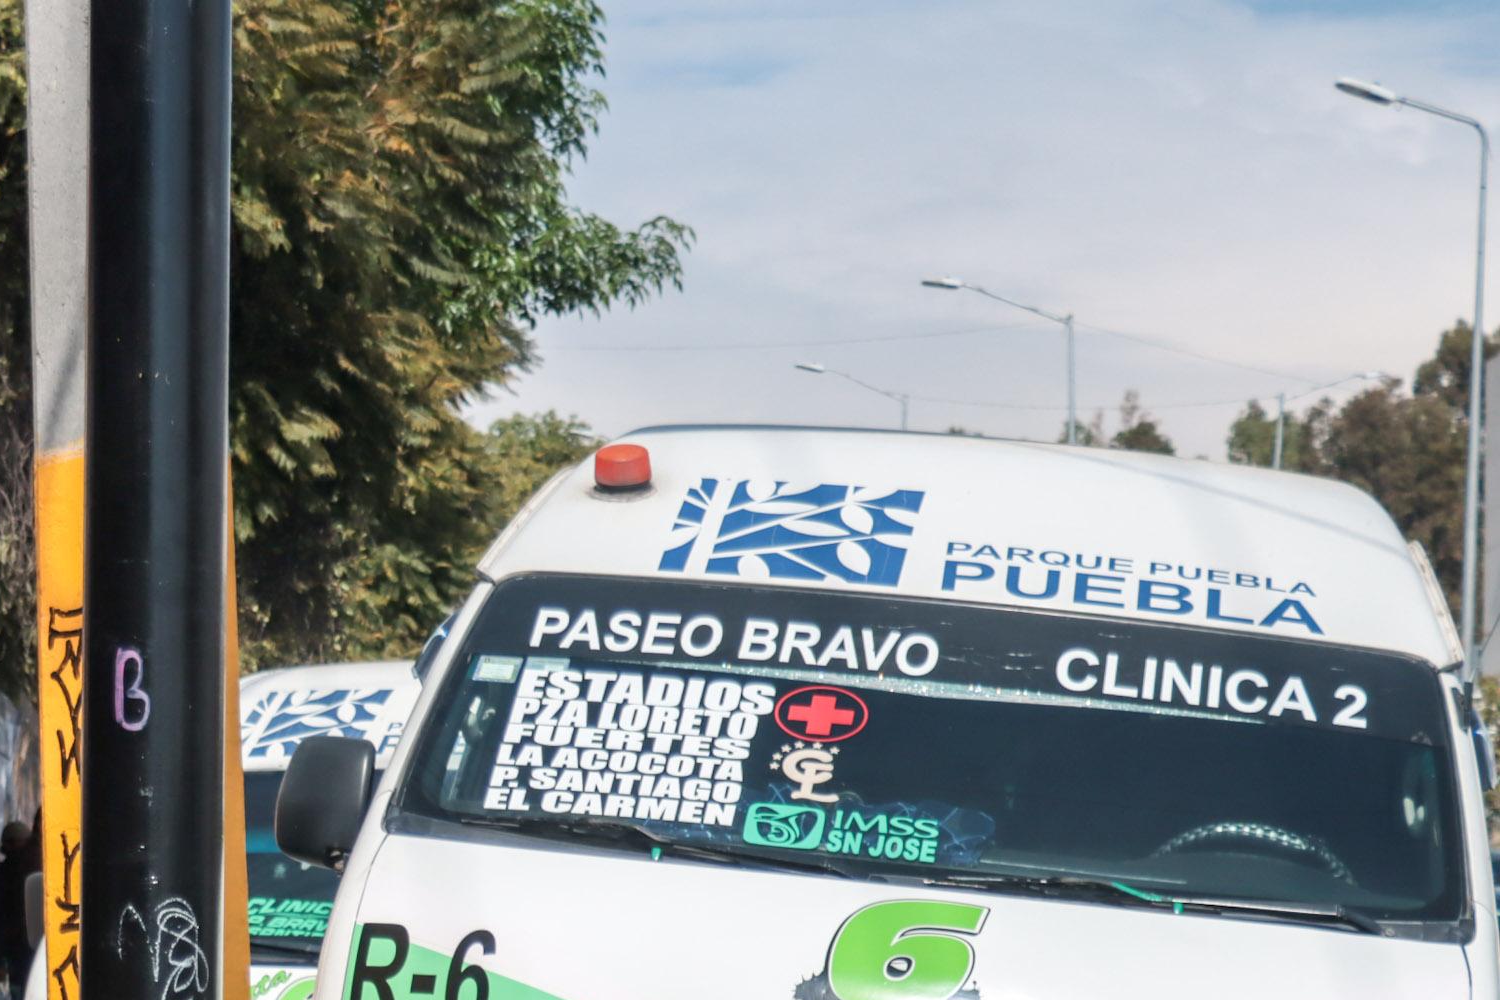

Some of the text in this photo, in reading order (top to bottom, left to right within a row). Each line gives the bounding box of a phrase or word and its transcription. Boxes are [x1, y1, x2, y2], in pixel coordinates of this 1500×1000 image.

[946, 542, 1316, 597] PARQUE PUEBLA
[941, 560, 1324, 635] PUEBLA
[529, 608, 939, 676] PASEO BRAVO
[517, 668, 776, 715] ESTADIOS
[1056, 648, 1368, 728] CLINICA 2
[511, 697, 759, 740] PZA LORETO
[503, 722, 750, 759] FUERTES
[496, 744, 743, 782] LA ACOCOTA
[489, 765, 742, 803] P. SANTIAGO
[483, 788, 736, 826] EL CARMEN
[834, 810, 939, 838] IMSS
[826, 831, 938, 863] SN JOSE
[248, 898, 334, 915] CLINIC
[267, 916, 328, 931] BRAV
